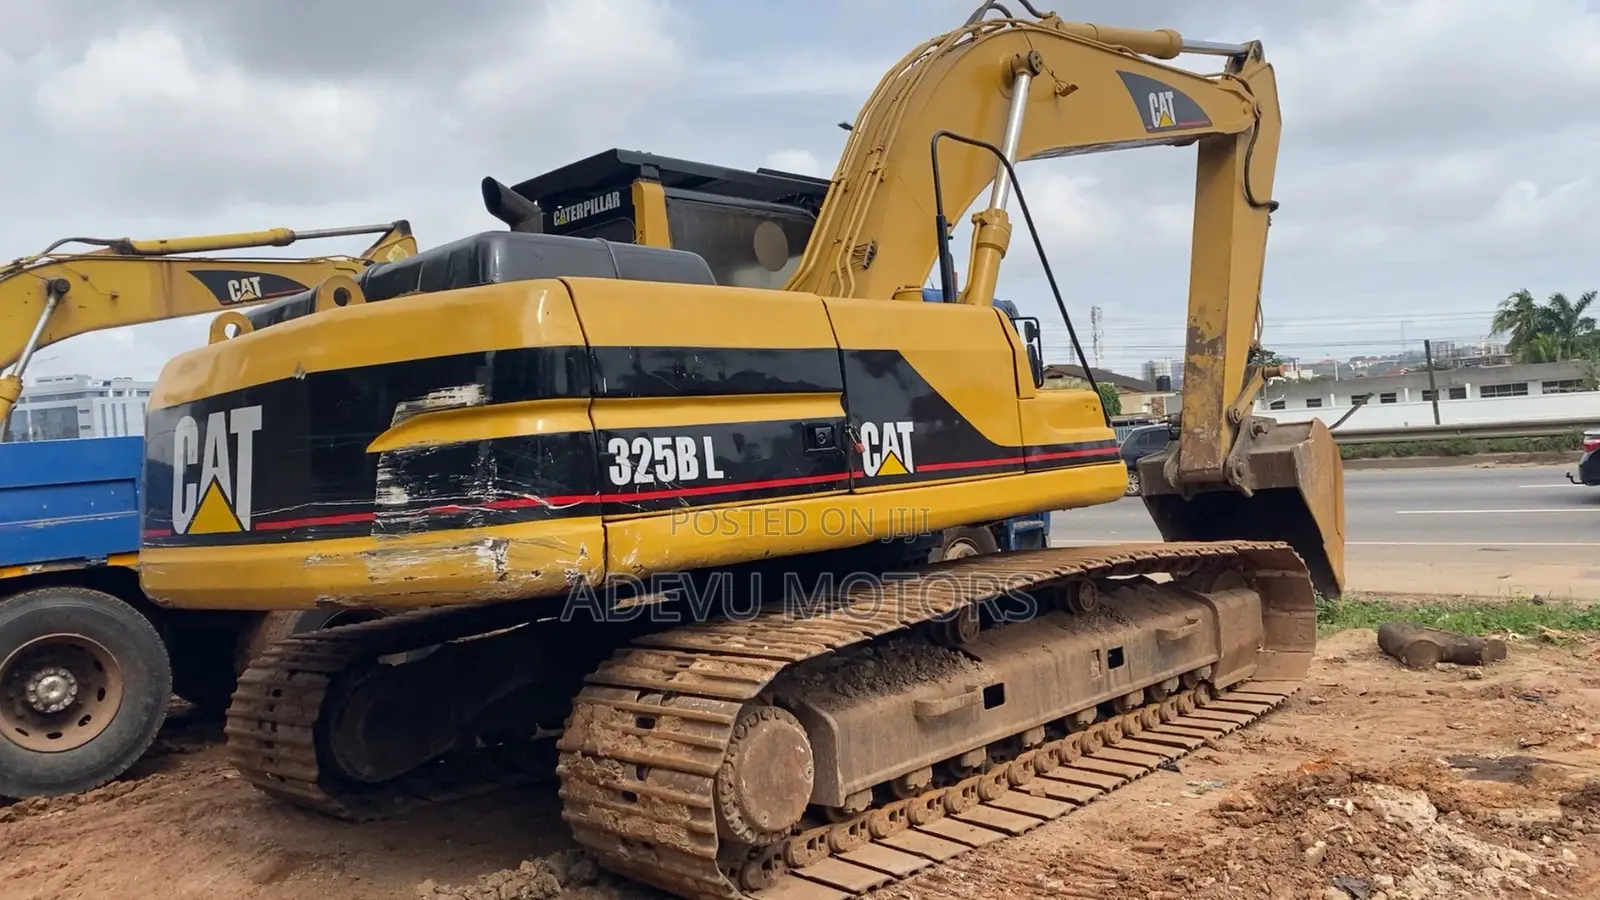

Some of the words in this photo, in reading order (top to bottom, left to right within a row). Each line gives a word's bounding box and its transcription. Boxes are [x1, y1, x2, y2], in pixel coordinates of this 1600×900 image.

[1148, 91, 1176, 128] CAT
[553, 191, 620, 227] CATERPILLAR
[227, 275, 262, 302] CAT
[172, 405, 263, 535] CAT
[608, 436, 698, 486] 325B
[703, 436, 724, 480] L
[861, 421, 914, 477] CAT
